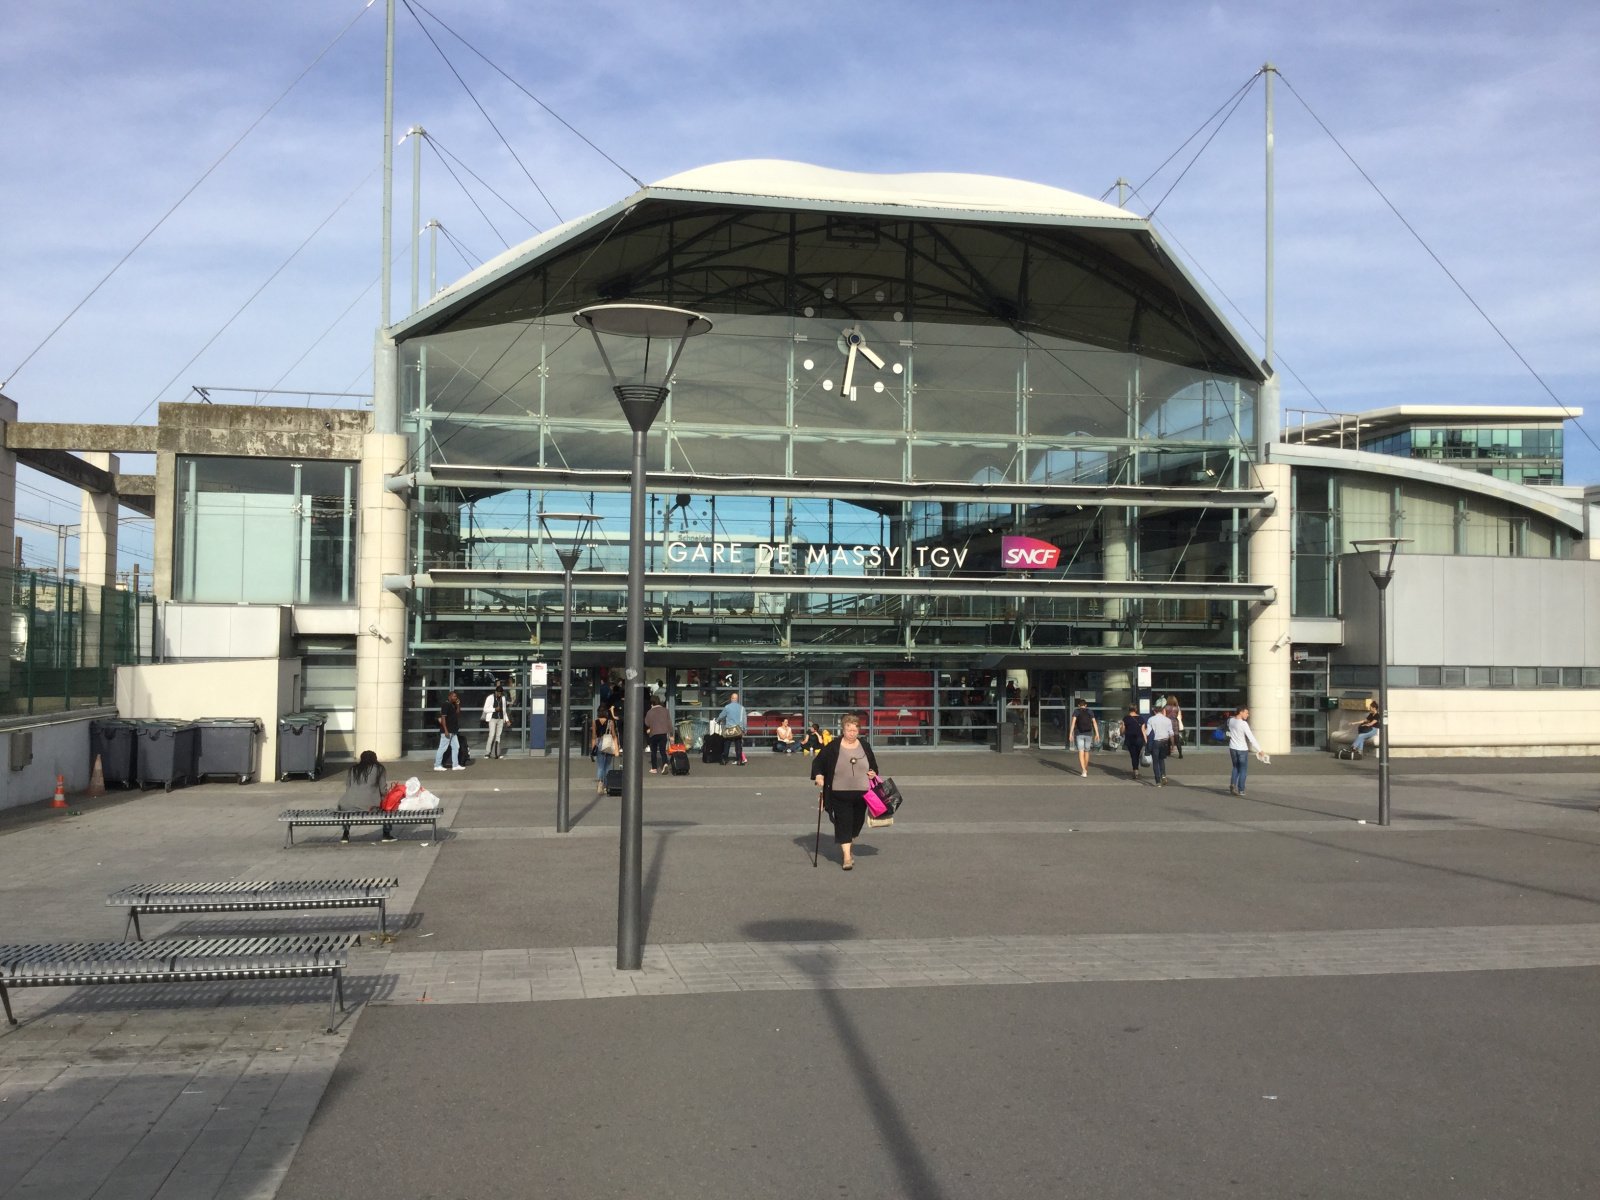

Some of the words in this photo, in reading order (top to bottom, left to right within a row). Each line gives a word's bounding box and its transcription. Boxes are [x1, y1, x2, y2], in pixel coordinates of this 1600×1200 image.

[667, 541, 742, 563] GARE
[758, 543, 791, 564] DE
[807, 544, 899, 566] MASSY
[916, 546, 969, 568] TGV
[1005, 548, 1057, 565] SNCF
